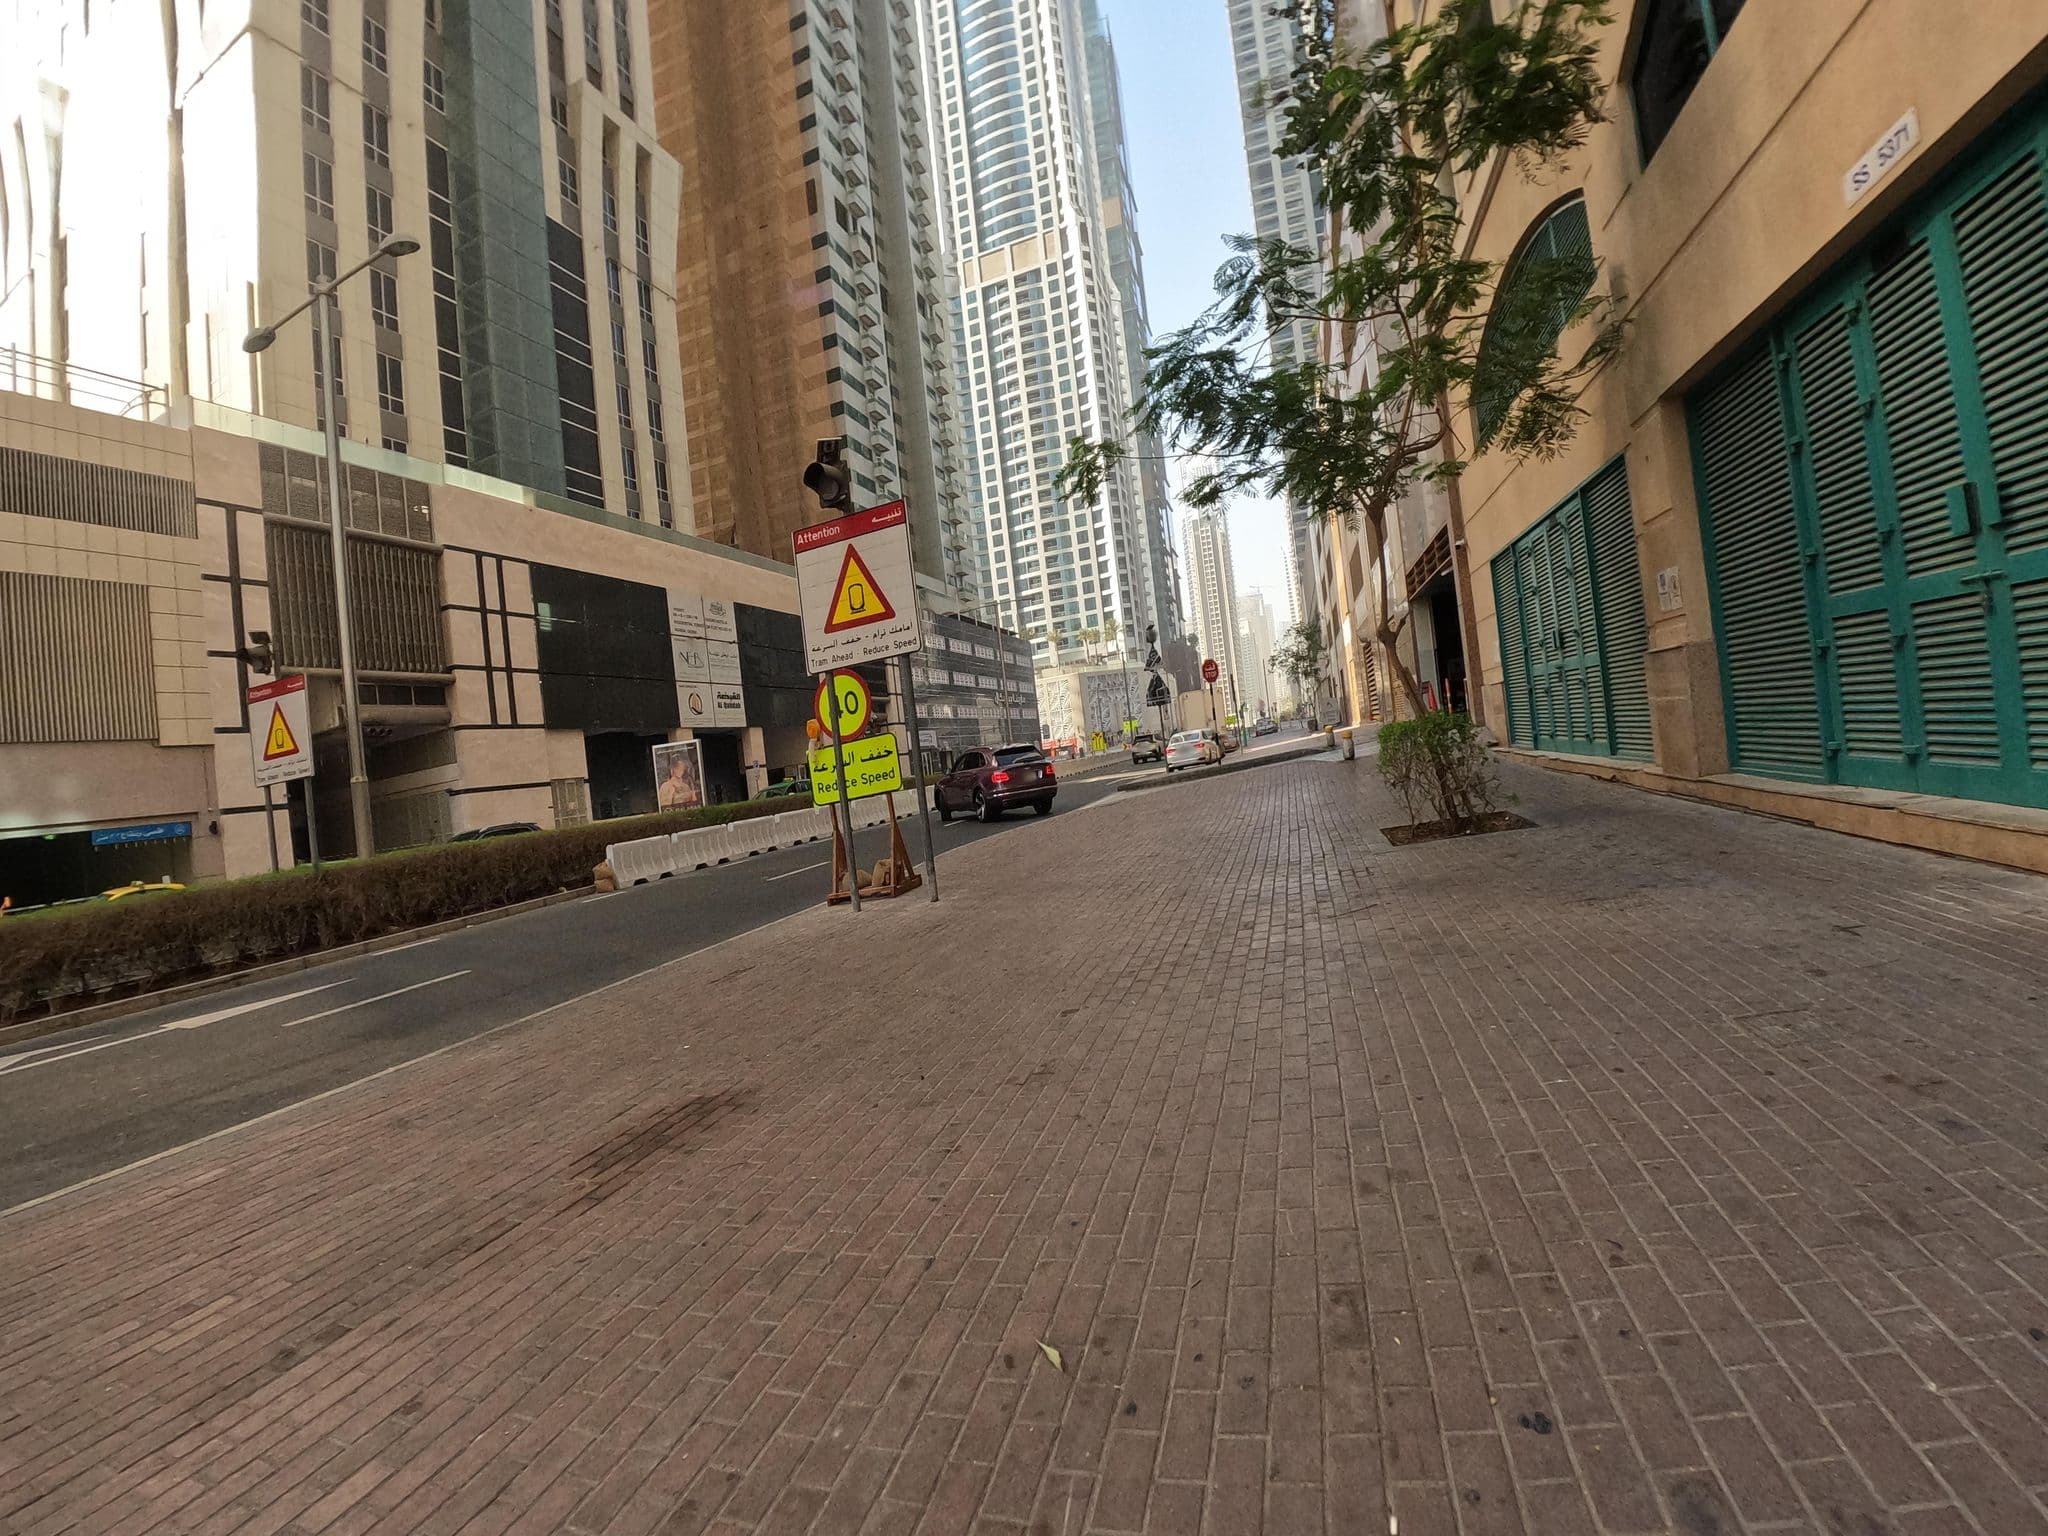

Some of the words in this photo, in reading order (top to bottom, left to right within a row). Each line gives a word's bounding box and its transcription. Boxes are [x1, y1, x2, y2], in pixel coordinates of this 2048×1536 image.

[796, 525, 841, 545] Attention
[841, 636, 861, 646] خفف
[872, 628, 886, 642] ترام
[811, 639, 838, 652] السرعة
[811, 658, 829, 667] Tram
[831, 651, 854, 663] Ahead
[862, 644, 890, 656] Reduce
[893, 636, 917, 650] Speed
[860, 745, 894, 763] خفف
[817, 779, 858, 794] Redce
[861, 767, 896, 786] Speed
